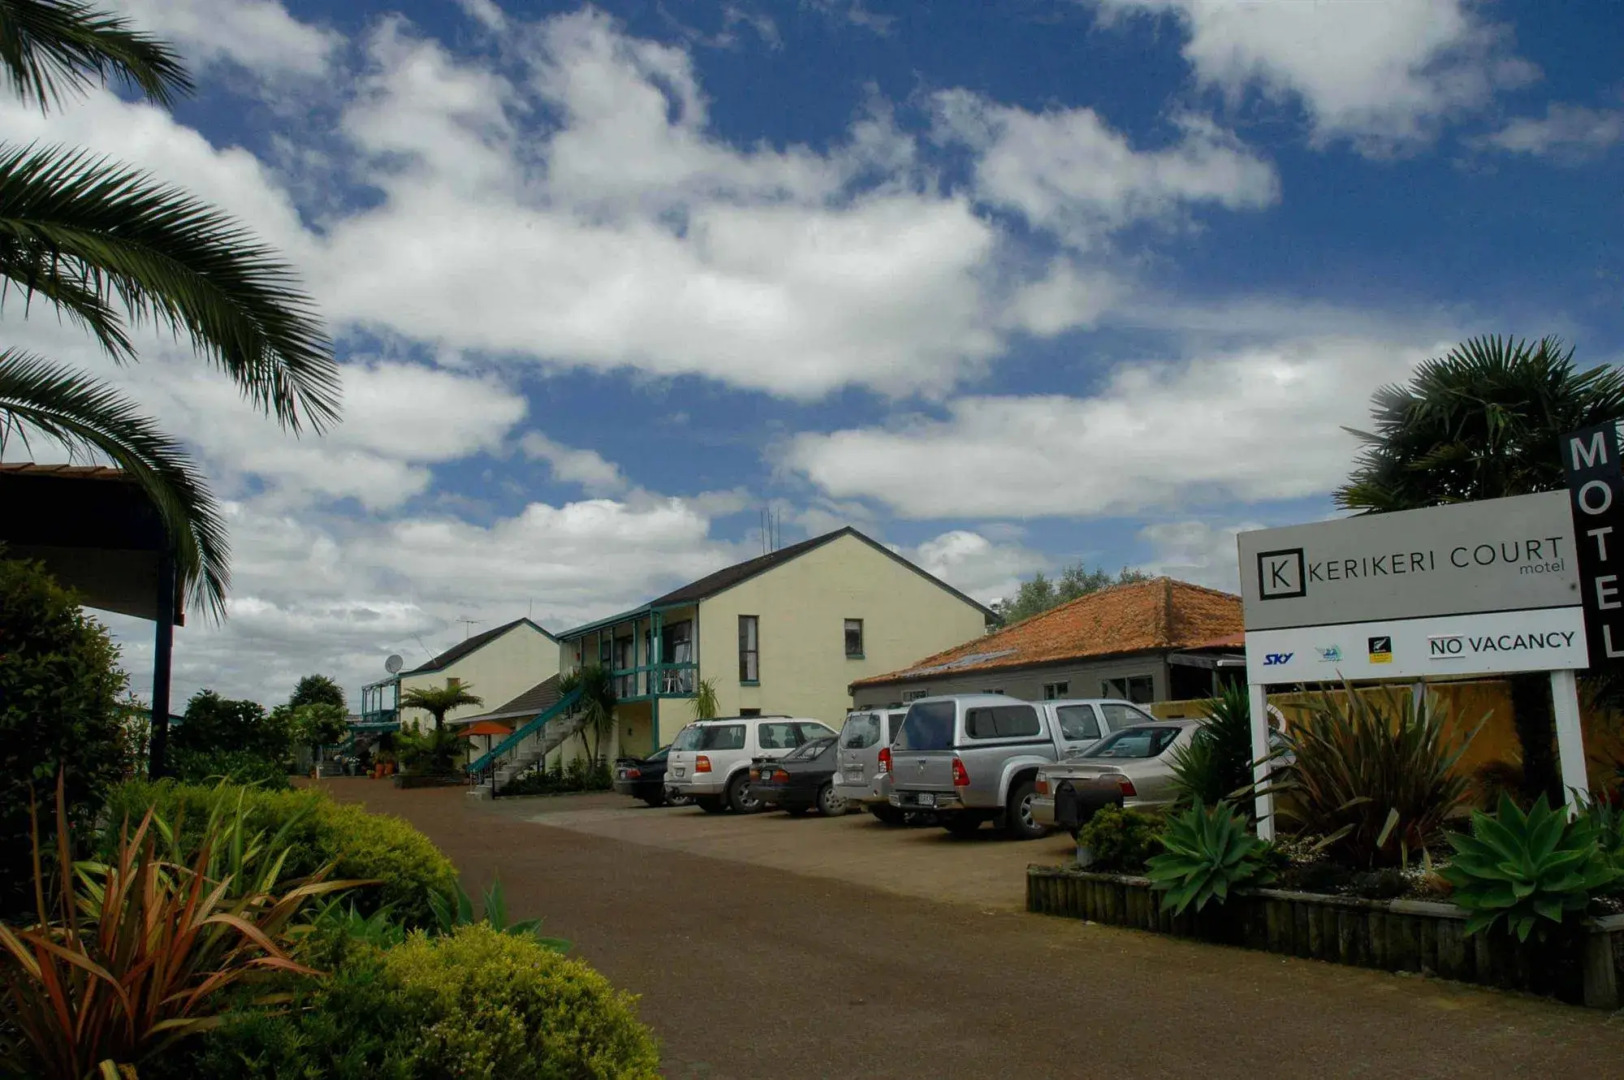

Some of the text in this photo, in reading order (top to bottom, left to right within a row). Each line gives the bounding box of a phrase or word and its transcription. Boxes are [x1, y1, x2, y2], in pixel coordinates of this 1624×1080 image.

[1570, 431, 1624, 658] MOTEL
[1309, 536, 1563, 583] KERIKERI COURT
[1519, 558, 1565, 576] motel
[1271, 560, 1291, 588] K
[1431, 631, 1576, 655] NO VACANCY
[1263, 652, 1294, 665] SKY
